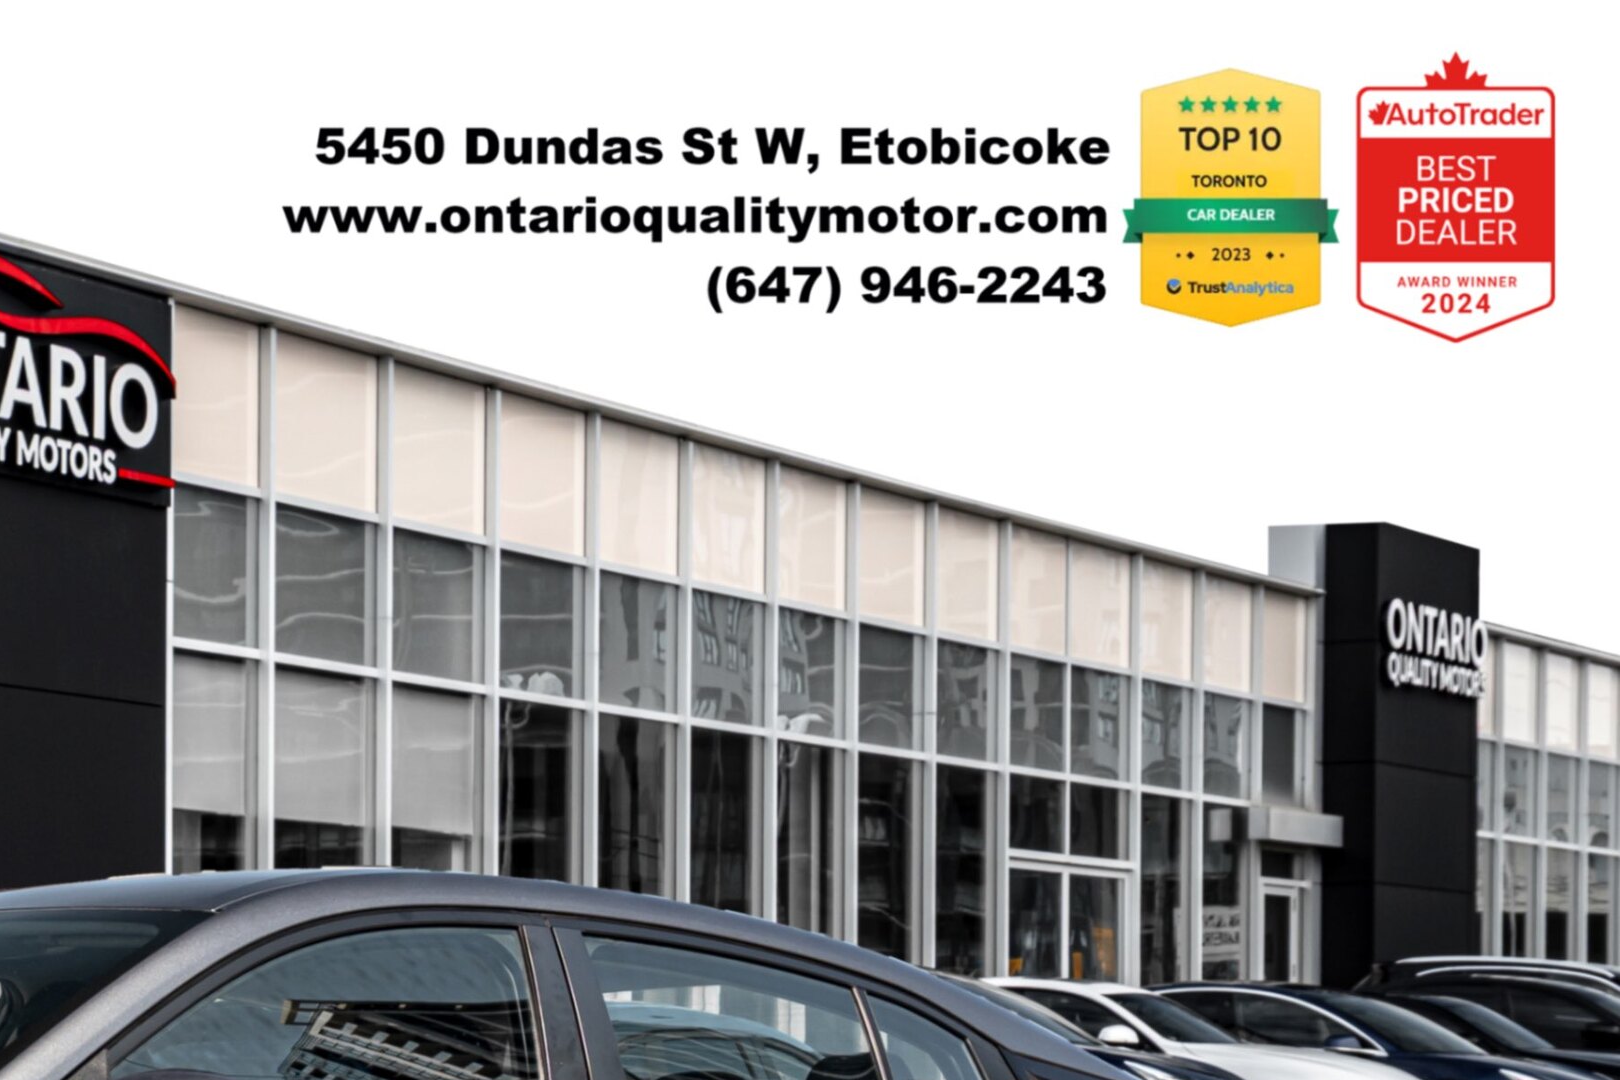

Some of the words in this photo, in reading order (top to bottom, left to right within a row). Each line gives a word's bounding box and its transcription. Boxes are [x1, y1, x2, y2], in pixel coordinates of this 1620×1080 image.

[16, 430, 117, 484] MOTORS
[1387, 598, 1488, 668] ONTARIO
[1388, 651, 1439, 690] QUALITY
